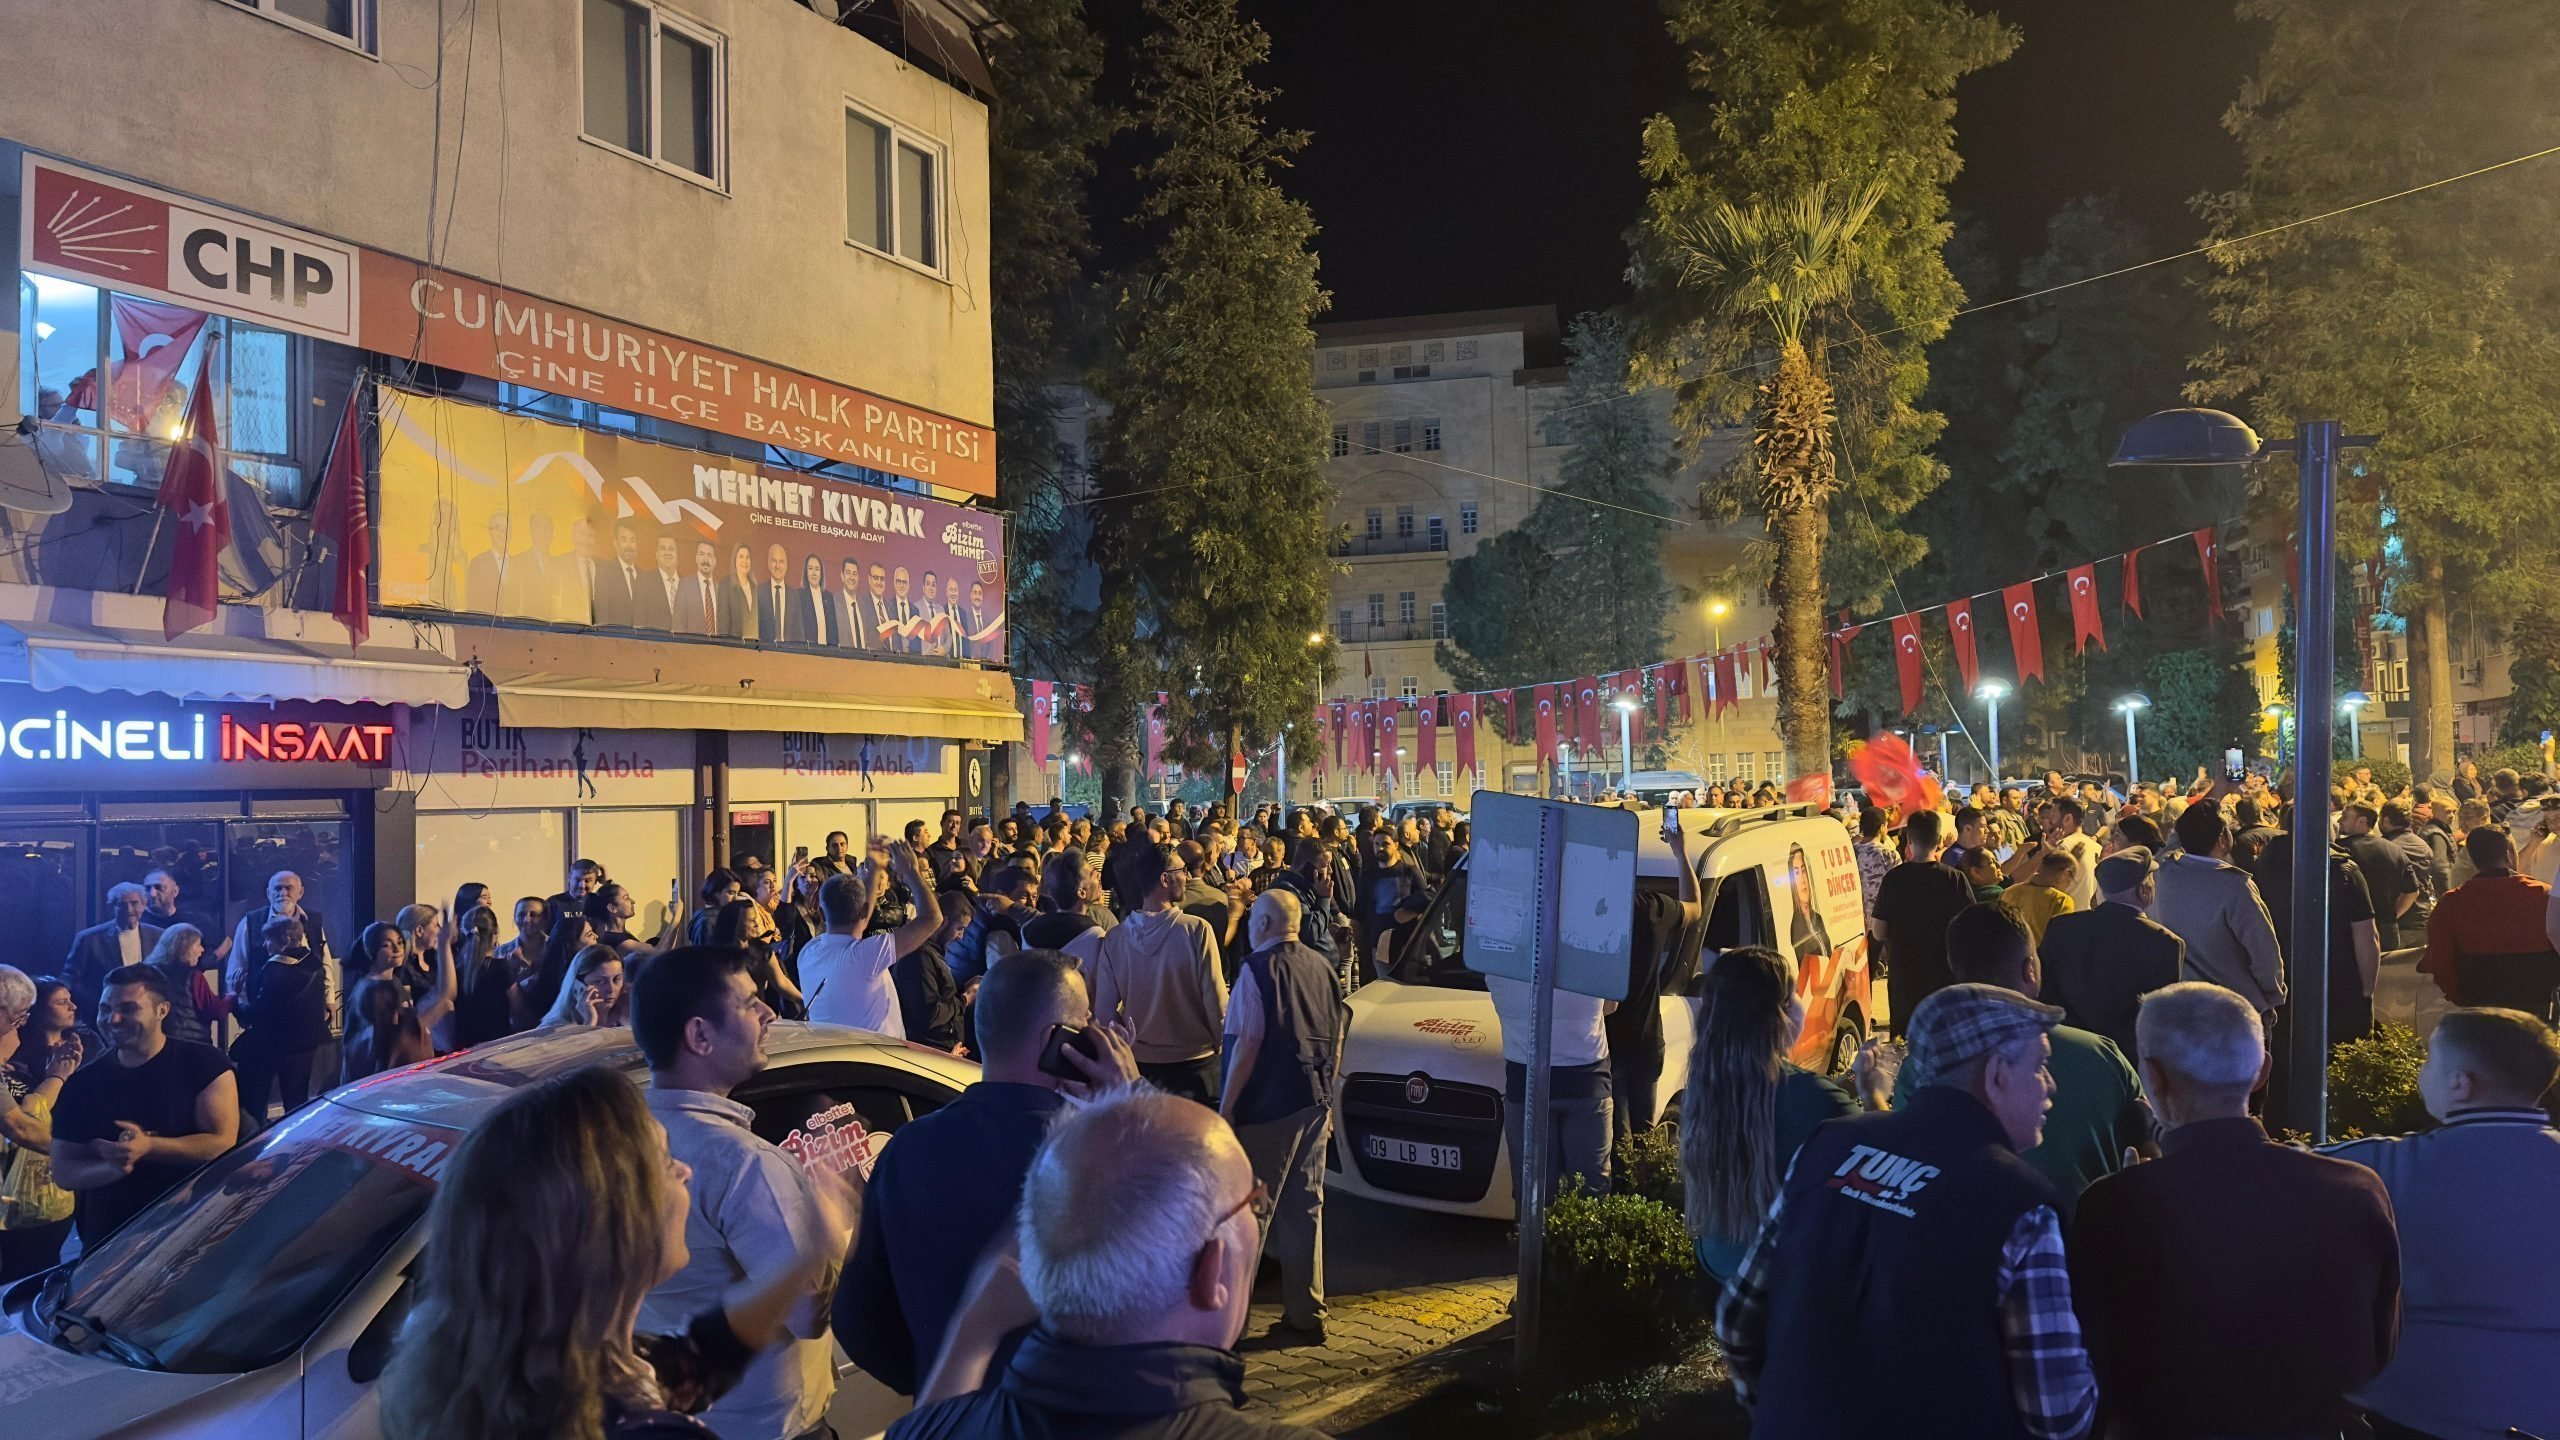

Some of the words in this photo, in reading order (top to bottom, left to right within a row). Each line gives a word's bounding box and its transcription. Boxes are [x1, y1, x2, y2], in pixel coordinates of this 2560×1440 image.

[182, 228, 334, 308] CHP
[753, 371, 851, 428] HALK
[744, 411, 937, 476] BAŞKANLIĞI
[692, 463, 815, 518] MEHMET
[821, 489, 926, 539] KIVRAK
[749, 511, 773, 525] ÇİNE
[775, 517, 819, 533] BELEDİYE
[820, 524, 859, 540] BAŞKANI
[860, 533, 885, 544] ADAYI
[941, 521, 985, 549] Bizim
[949, 542, 986, 561] MEHMET
[978, 561, 997, 574] EVET
[461, 751, 575, 779] Perihan
[592, 751, 655, 779] Abla
[782, 752, 860, 777] Perihan
[871, 754, 915, 777] Abla
[1820, 845, 1852, 870] TUBA
[1419, 1026, 1473, 1036] MEHMET
[806, 1103, 854, 1129] elbette;
[1370, 1138, 1387, 1158] 09
[1399, 1142, 1417, 1163] LB
[1431, 1147, 1459, 1168] 913
[1833, 1144, 1942, 1200] TUNÇ
